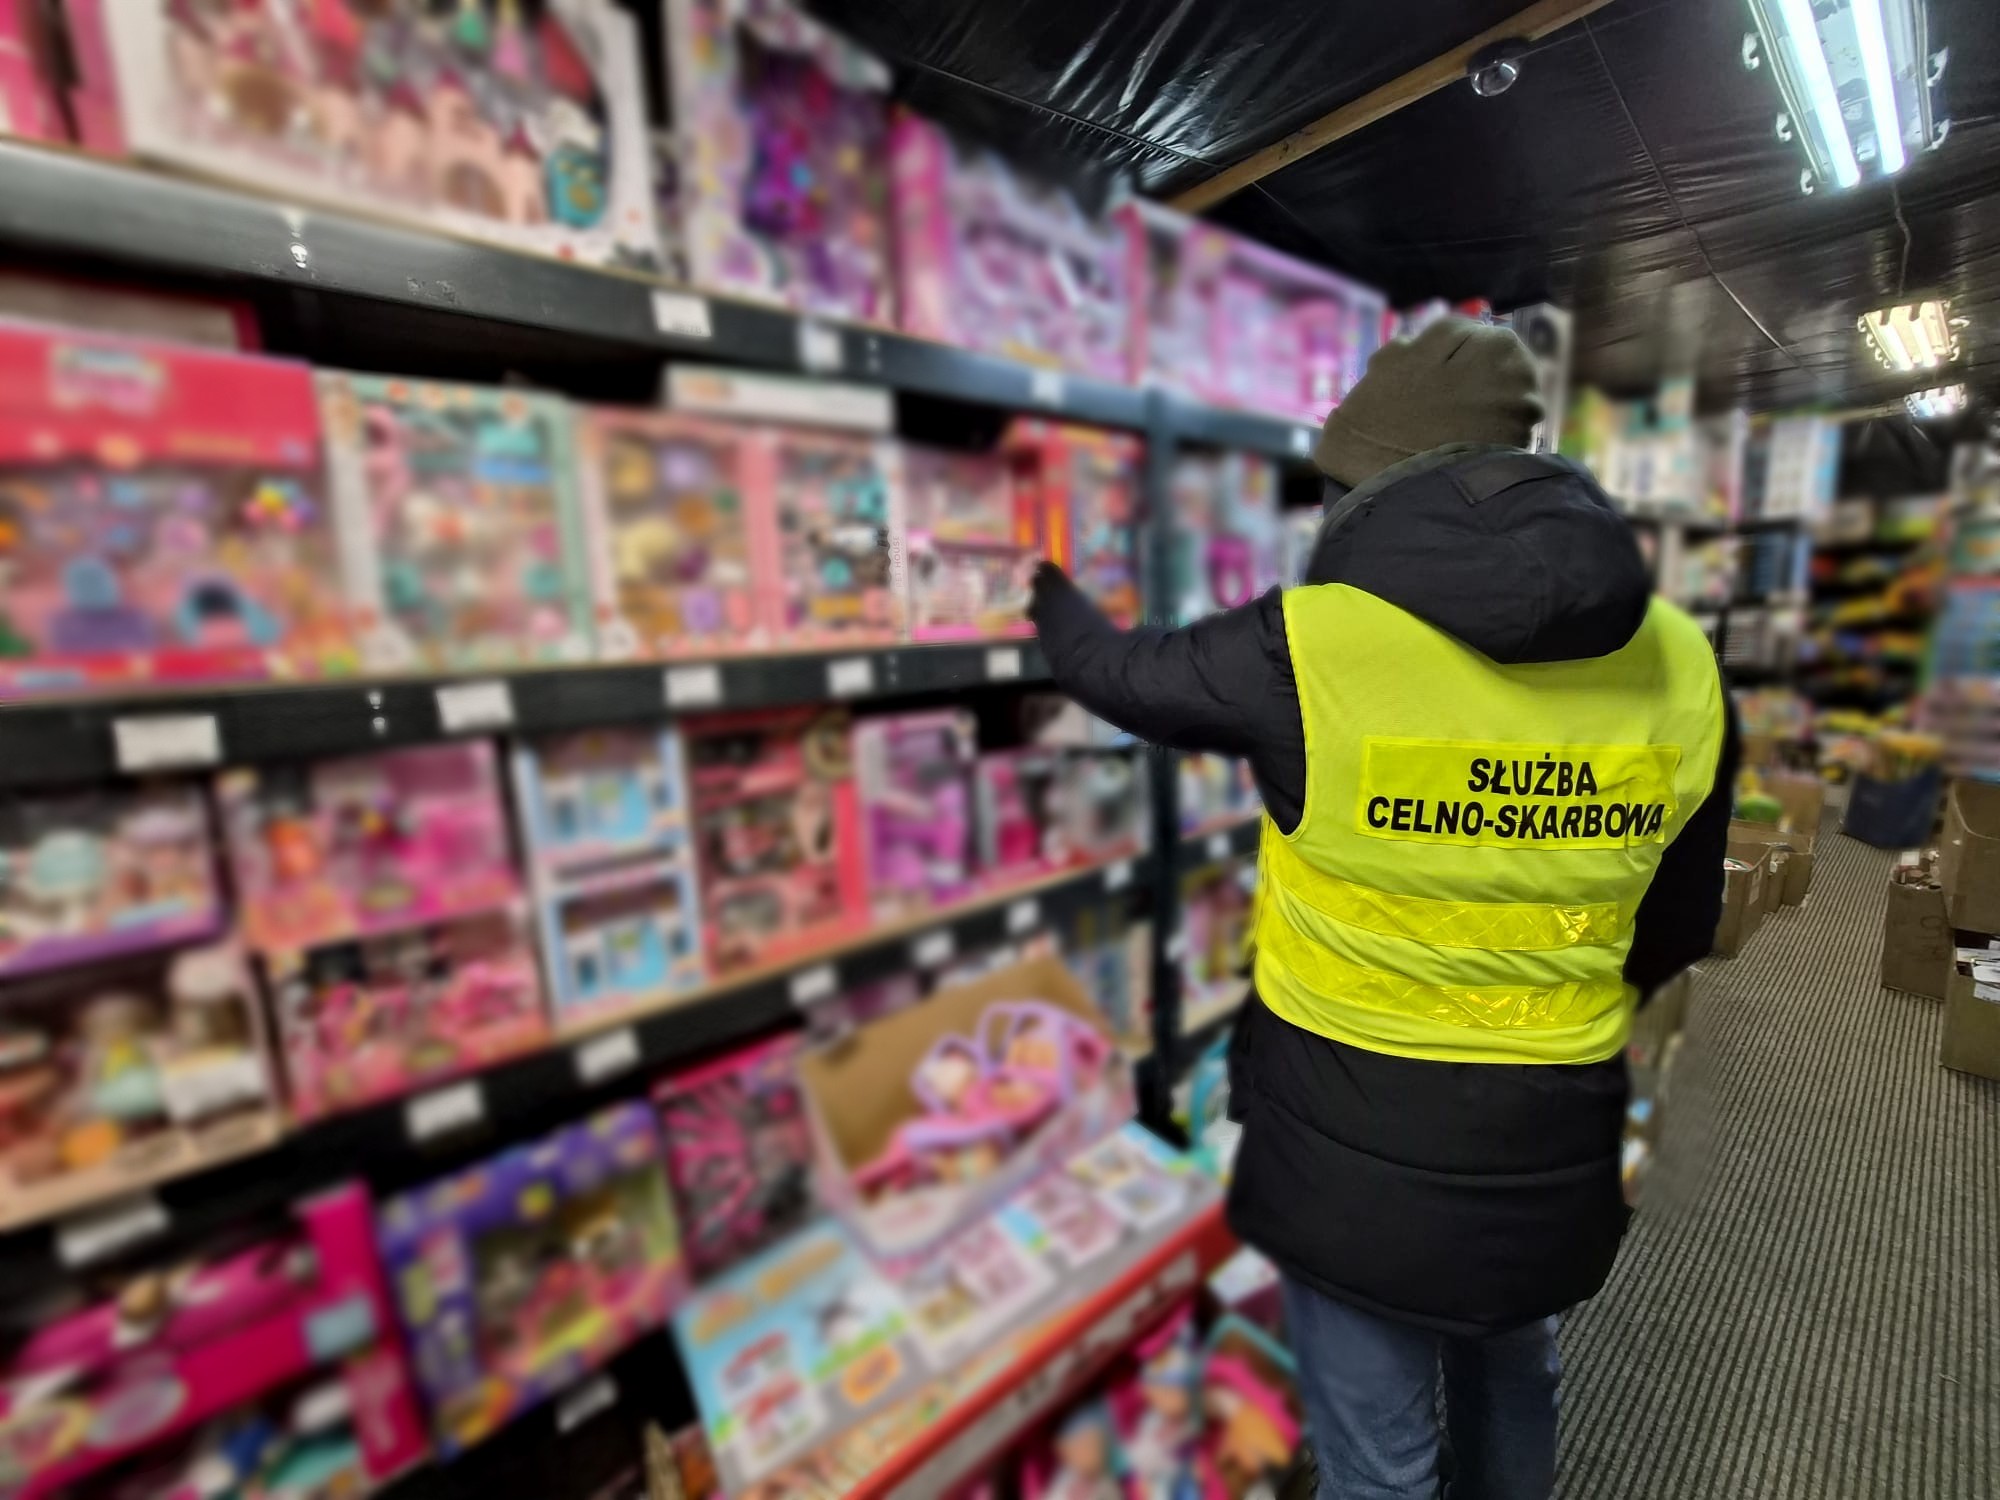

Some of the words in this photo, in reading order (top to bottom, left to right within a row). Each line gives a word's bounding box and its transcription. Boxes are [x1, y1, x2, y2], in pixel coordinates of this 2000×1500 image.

[893, 536, 902, 568] HOUSE
[1467, 752, 1597, 796] SŁUŻBA
[1367, 795, 1665, 839] CELNO-SKARBOWA
